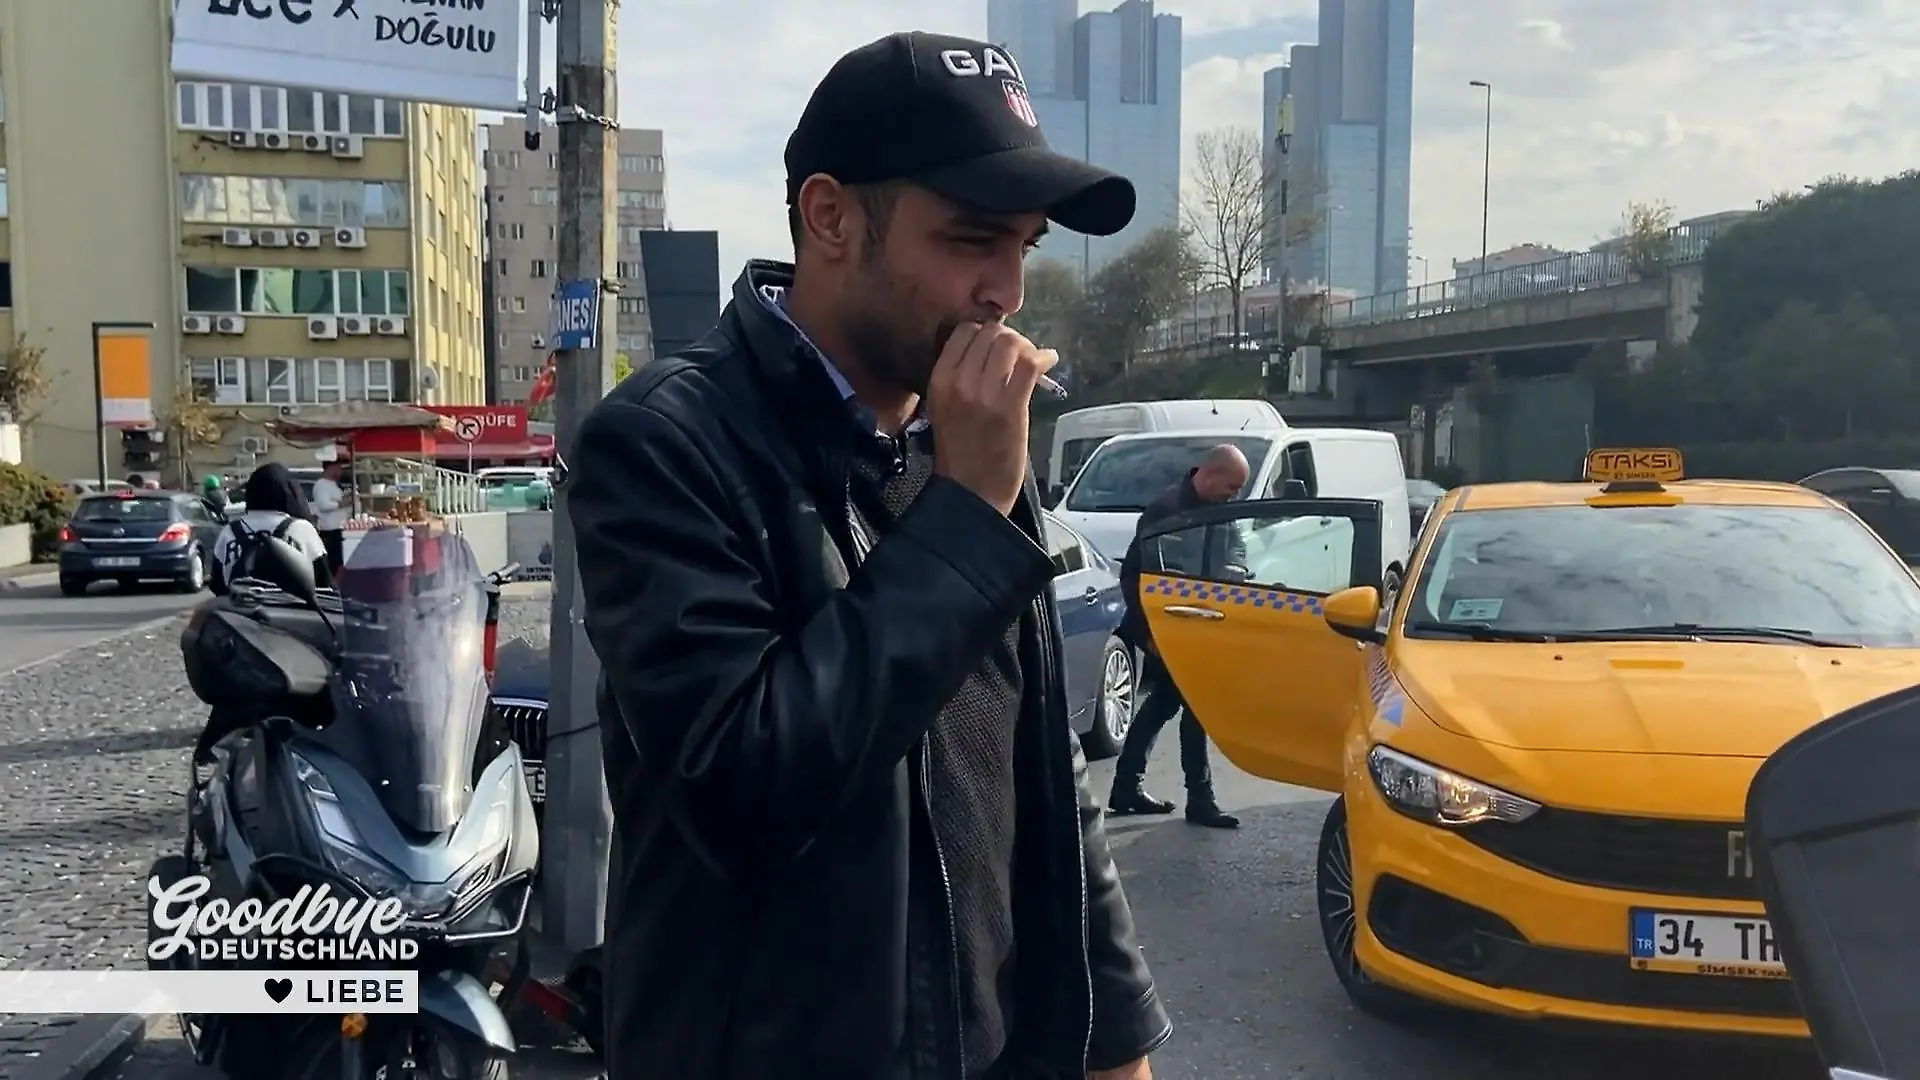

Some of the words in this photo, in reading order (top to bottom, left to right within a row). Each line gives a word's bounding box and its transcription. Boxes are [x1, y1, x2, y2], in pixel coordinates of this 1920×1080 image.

[374, 11, 497, 53] DOĞULU
[941, 48, 1026, 84] GA
[1636, 937, 1652, 950] TR
[1659, 919, 1704, 957] 34
